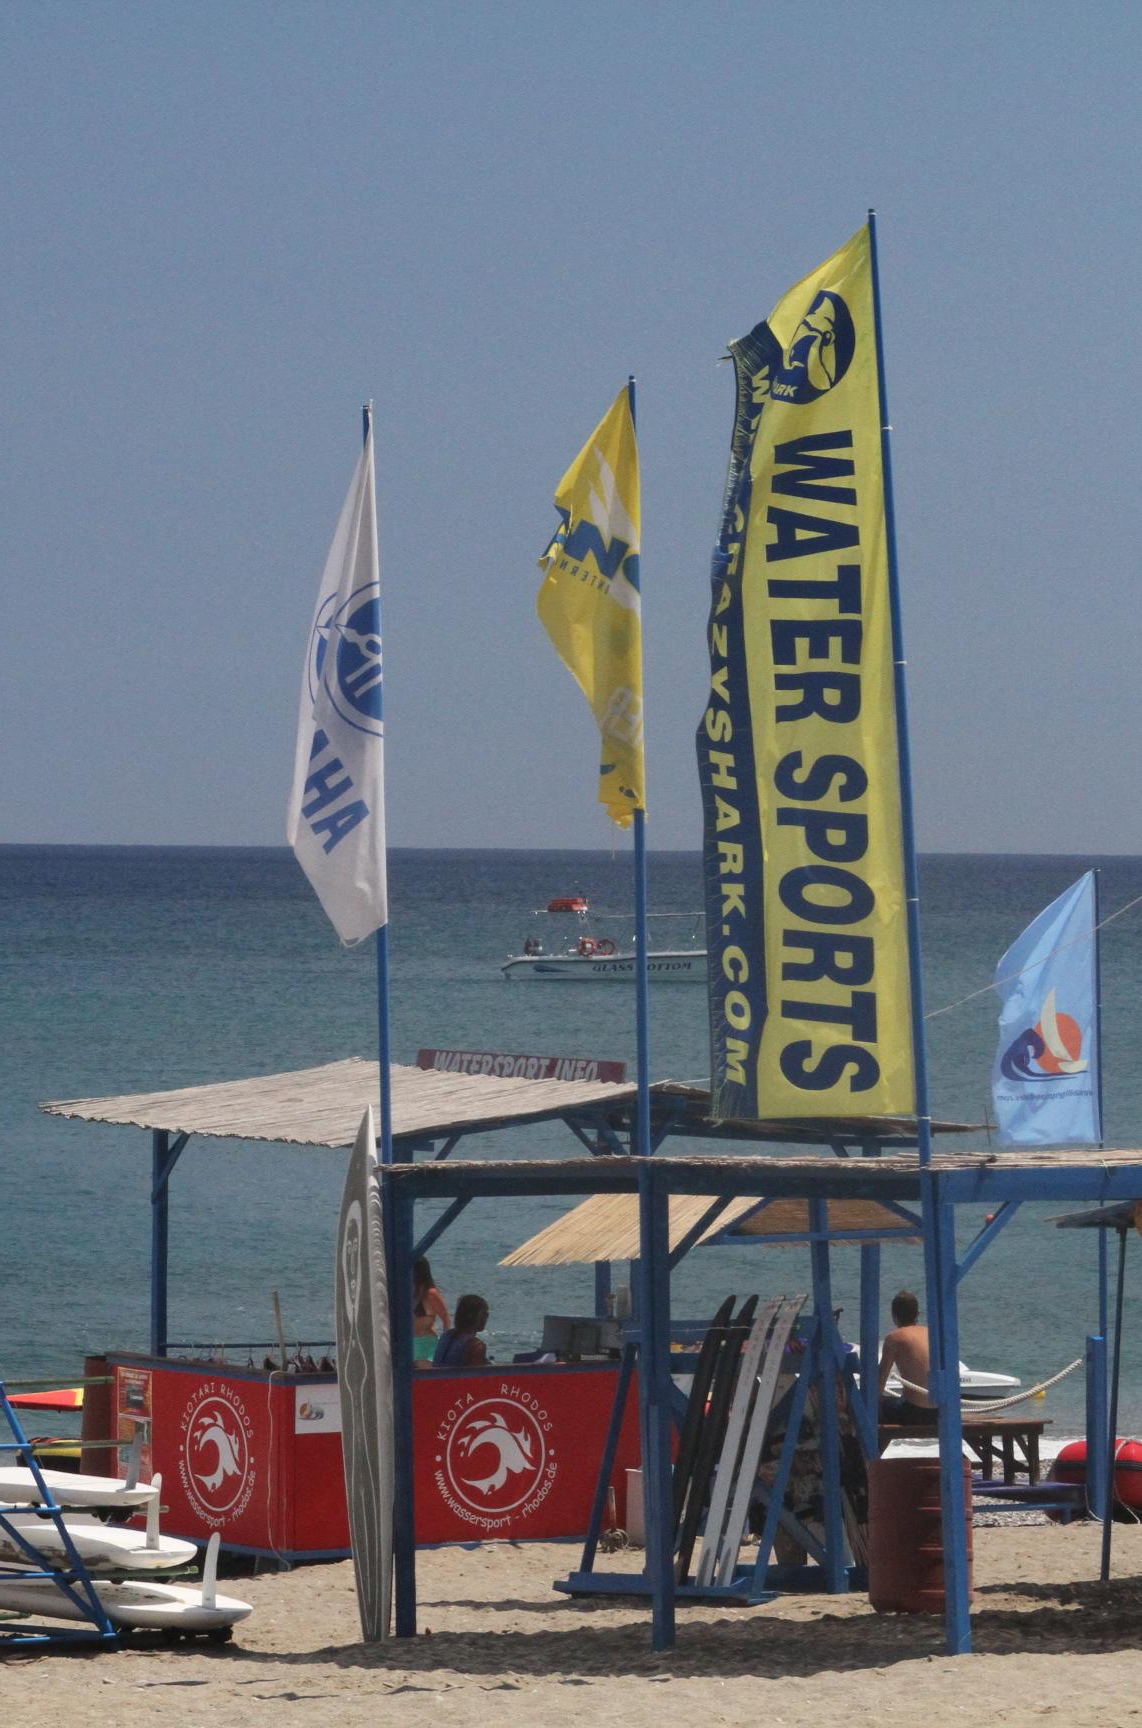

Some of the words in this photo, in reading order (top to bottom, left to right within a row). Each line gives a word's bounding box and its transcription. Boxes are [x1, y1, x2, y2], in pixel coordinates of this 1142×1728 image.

[765, 429, 862, 723] WATER
[773, 750, 880, 1093] SPORTS
[593, 963, 635, 973] GLASS
[645, 962, 692, 972] OTTOM
[433, 1051, 551, 1080] WATERSPORT
[180, 1382, 215, 1431] KIOTARI
[220, 1383, 254, 1439] RHODOS
[500, 1383, 553, 1432] RHODOS
